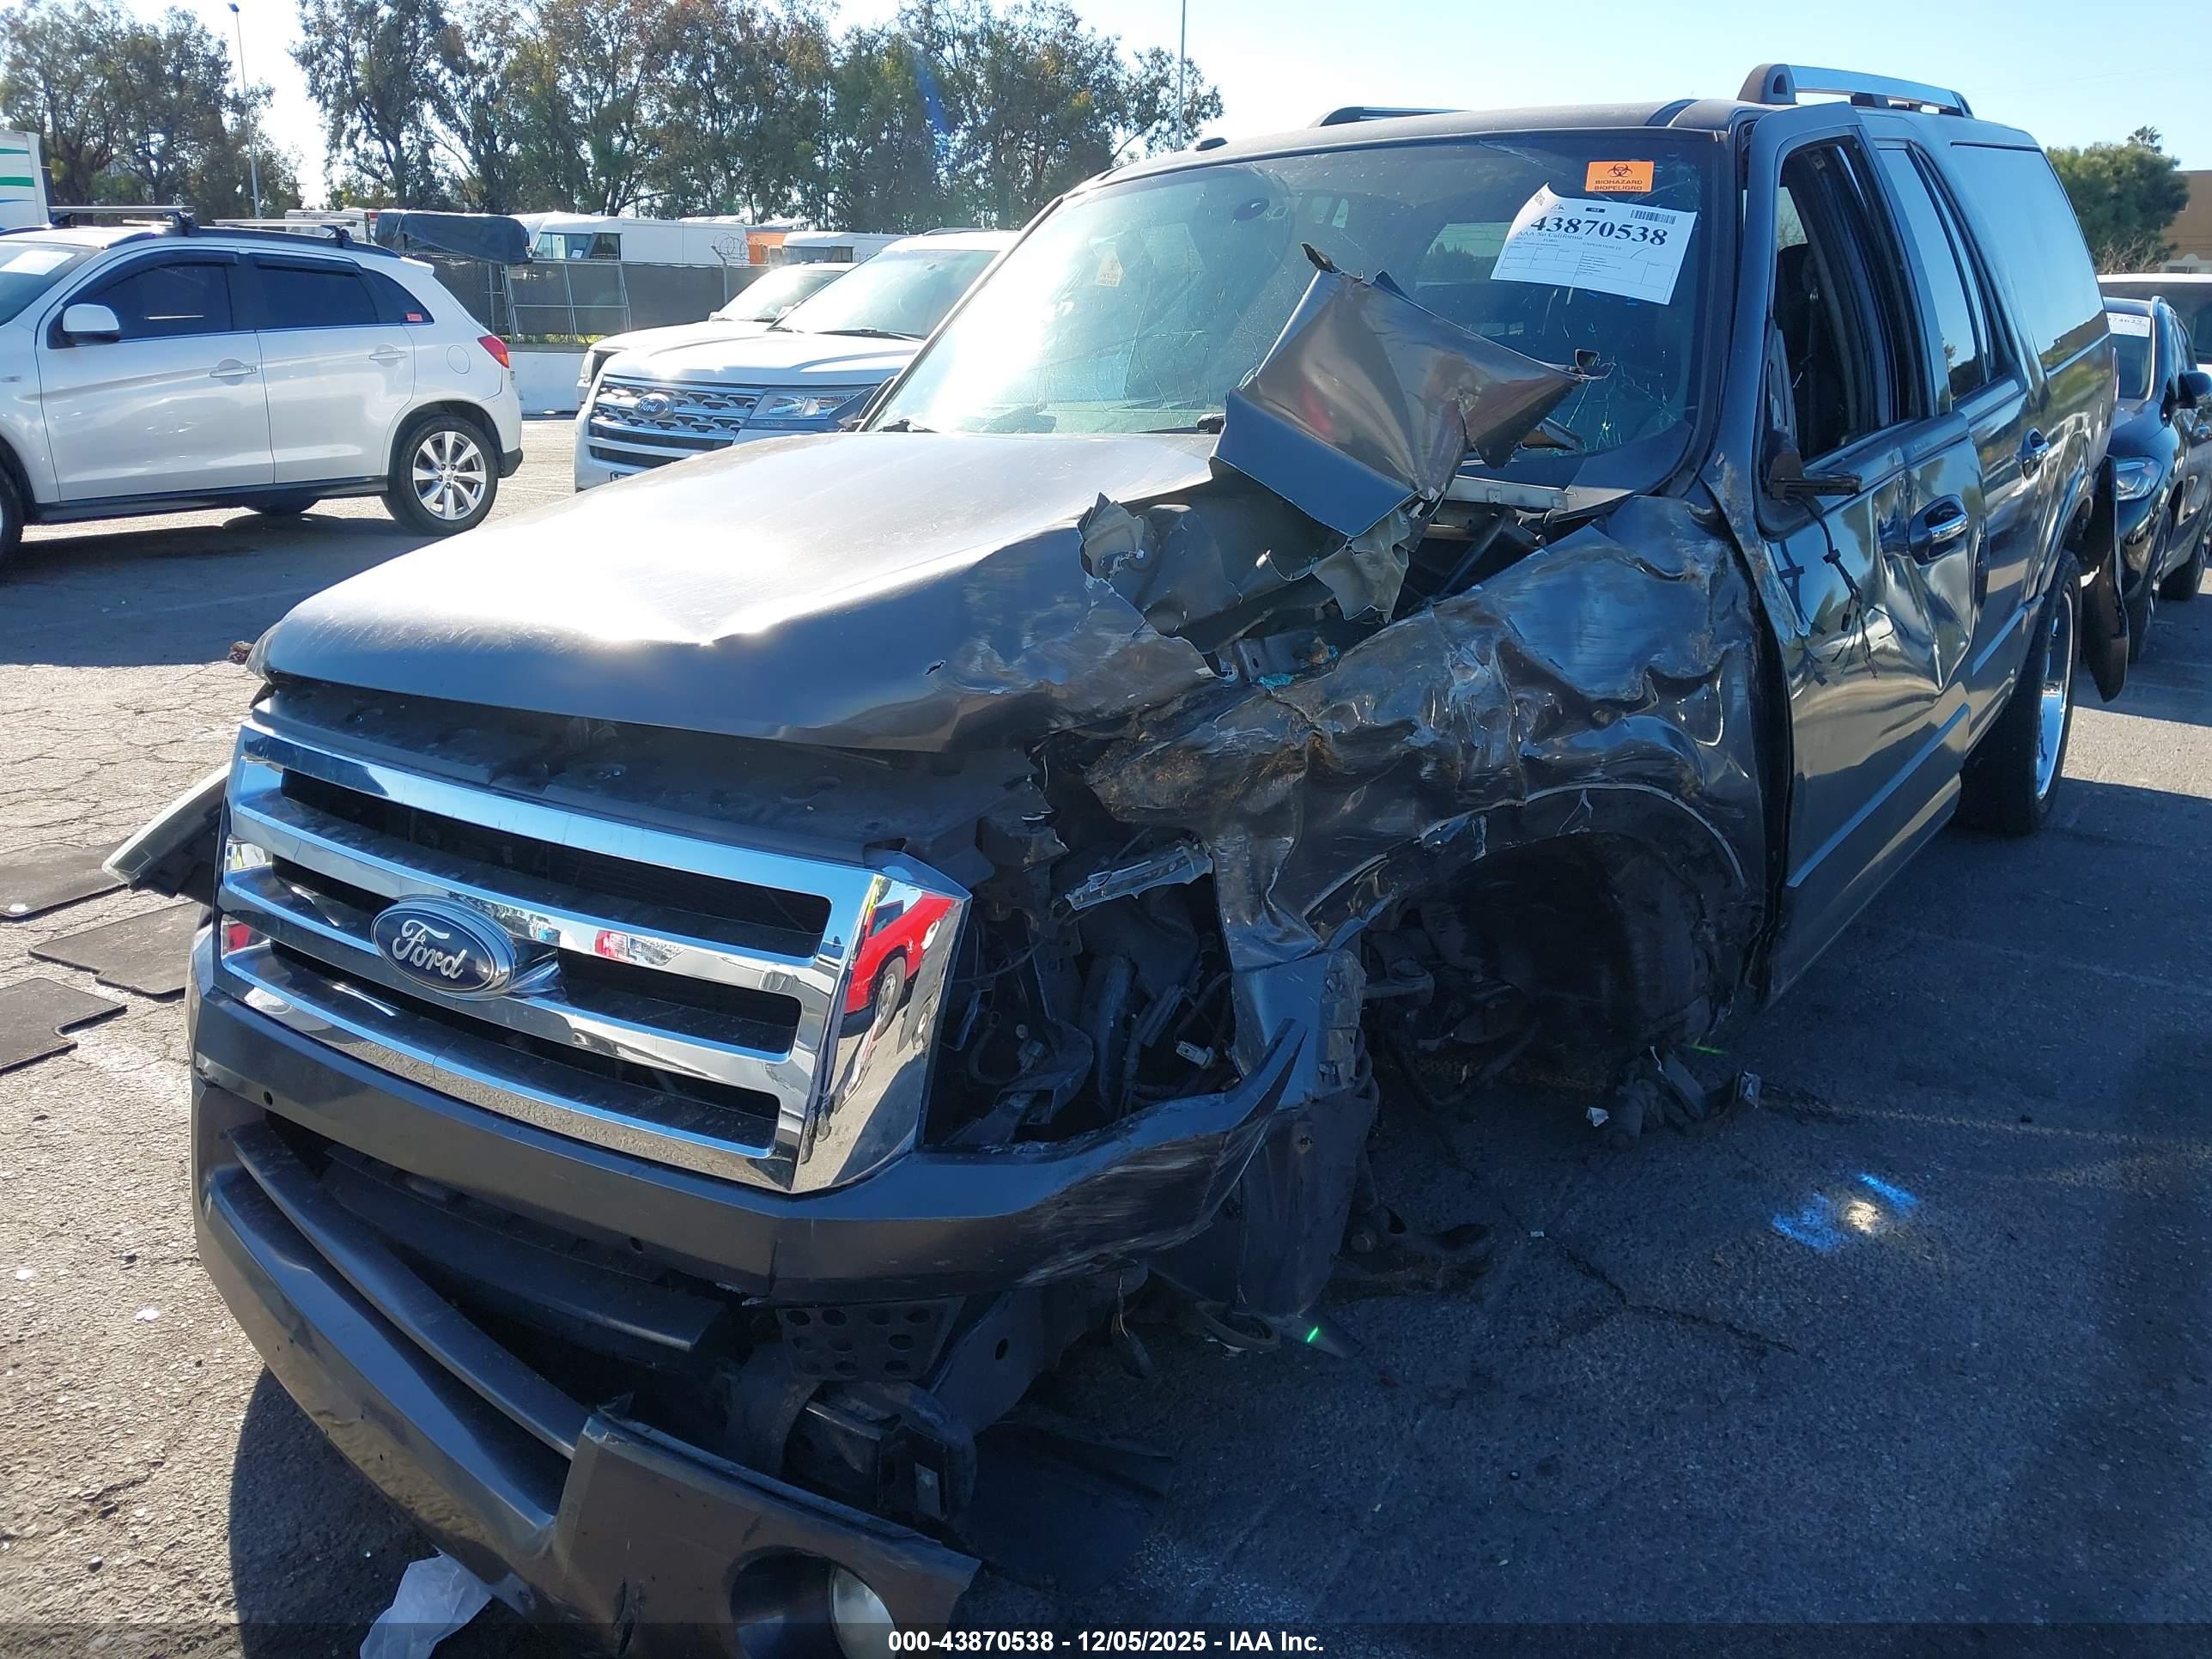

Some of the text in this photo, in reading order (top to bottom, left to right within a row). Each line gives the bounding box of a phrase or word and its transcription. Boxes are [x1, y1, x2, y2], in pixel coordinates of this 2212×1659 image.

[1530, 216, 1668, 246] 43870538
[1548, 232, 1583, 240] California
[638, 397, 659, 412] Ford
[392, 919, 468, 980] Ford
